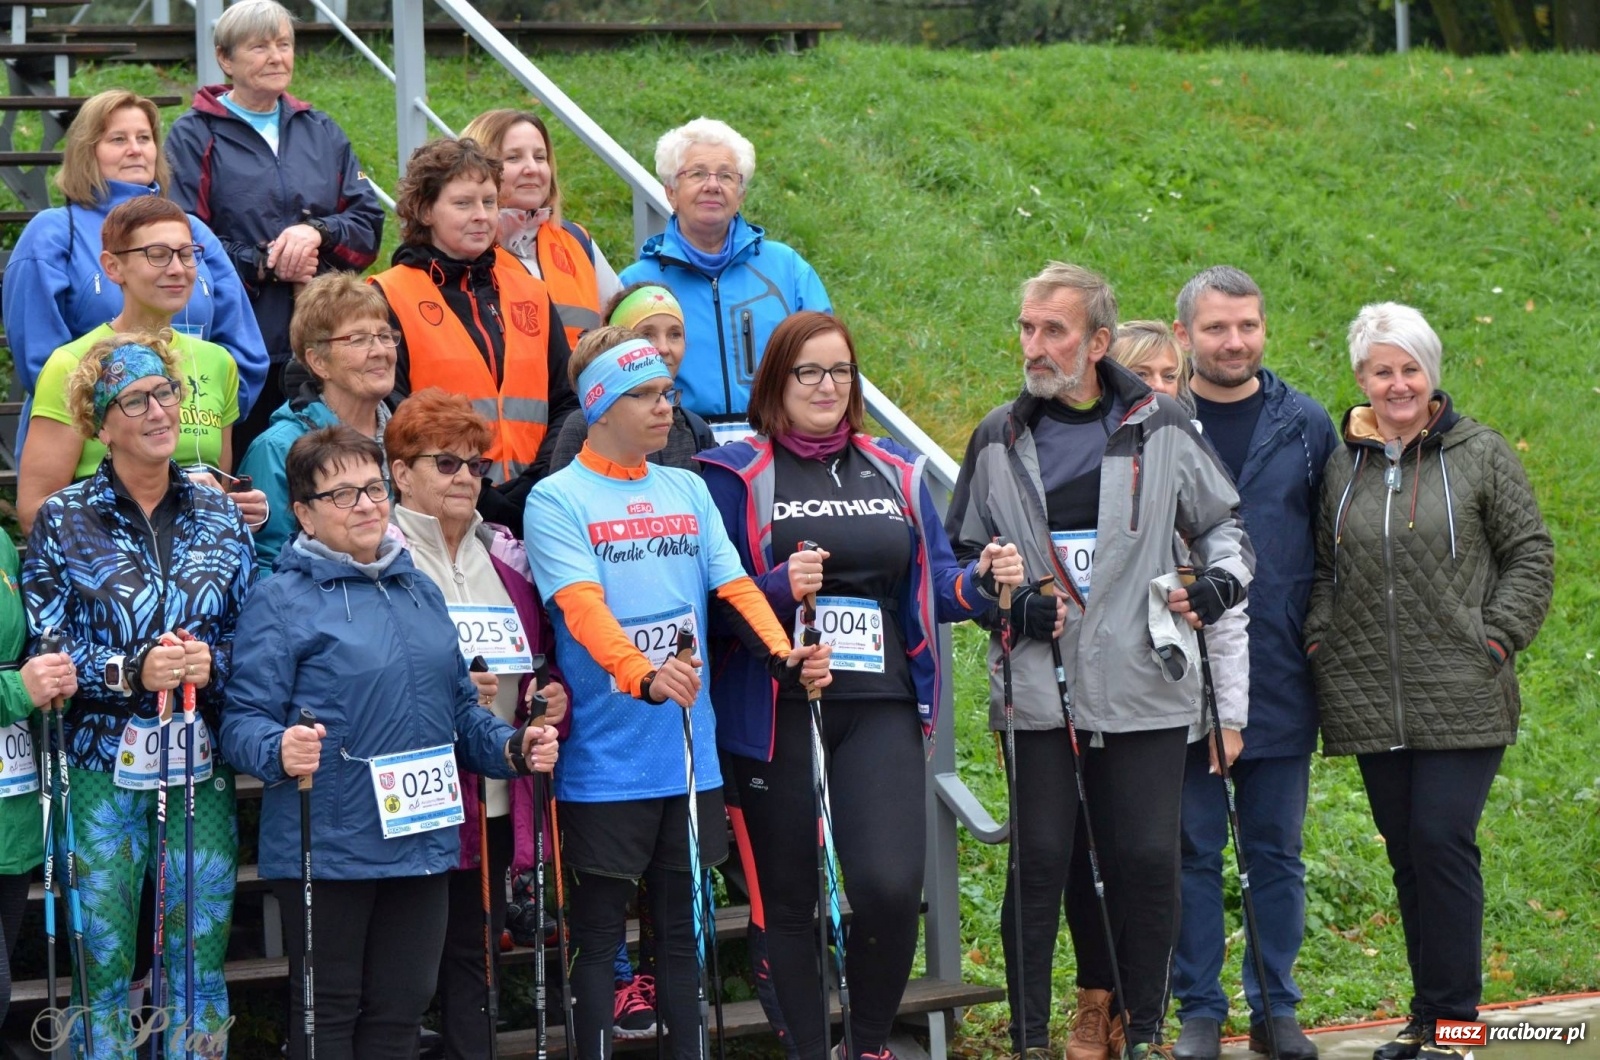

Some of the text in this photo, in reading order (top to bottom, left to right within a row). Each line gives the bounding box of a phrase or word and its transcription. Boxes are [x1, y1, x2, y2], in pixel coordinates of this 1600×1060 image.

[773, 498, 903, 521] DECATHLON
[632, 517, 697, 535] LOVE
[594, 540, 646, 563] Nordic
[456, 621, 503, 643] 025
[822, 610, 867, 635] 004
[634, 623, 678, 652] 022
[402, 767, 444, 798] 023
[157, 780, 167, 822] LEKI
[44, 855, 53, 889] VENTO
